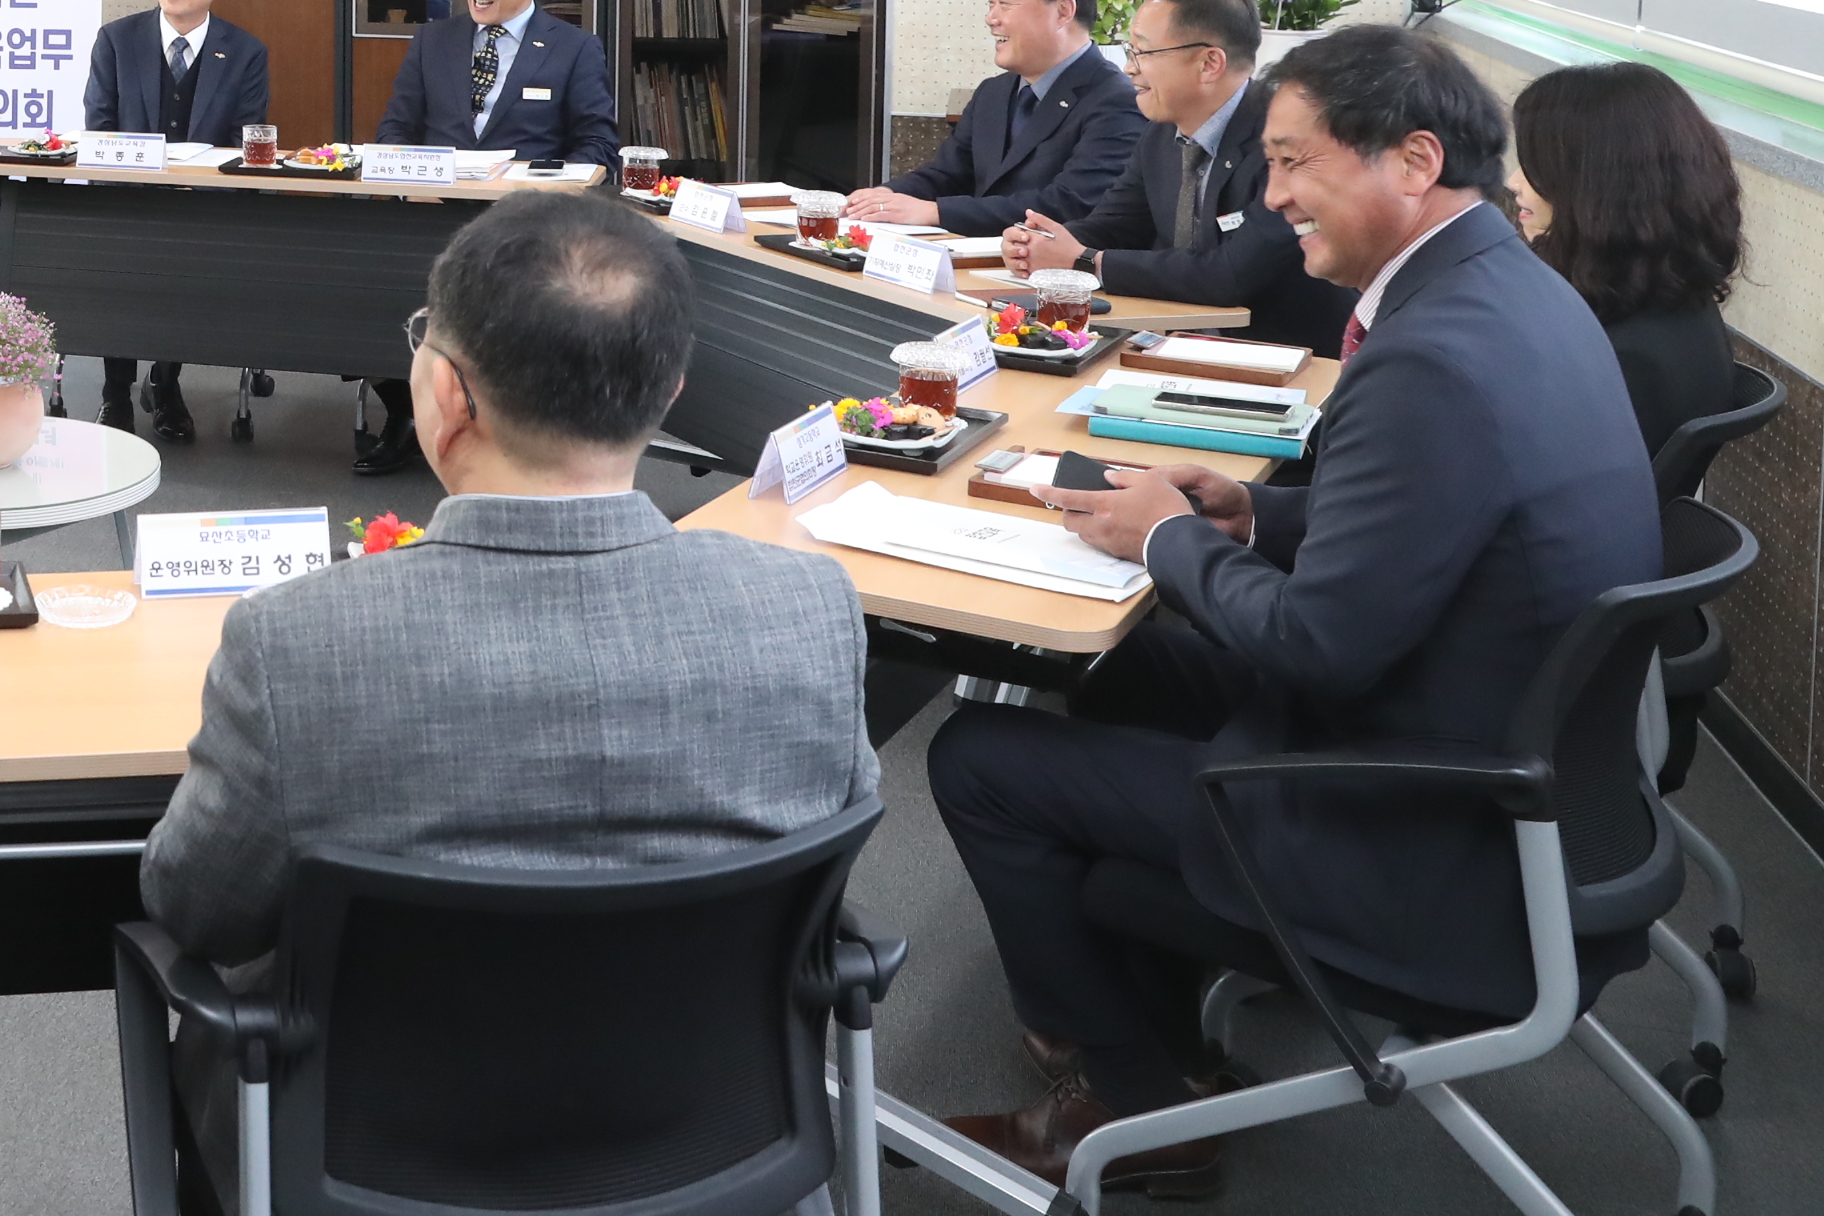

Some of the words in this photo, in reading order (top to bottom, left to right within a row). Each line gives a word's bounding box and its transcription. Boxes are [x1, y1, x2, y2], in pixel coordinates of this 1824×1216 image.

[371, 165, 395, 175] 교육장
[198, 528, 272, 544] 묘산초등학교
[148, 557, 233, 579] 운영위원장
